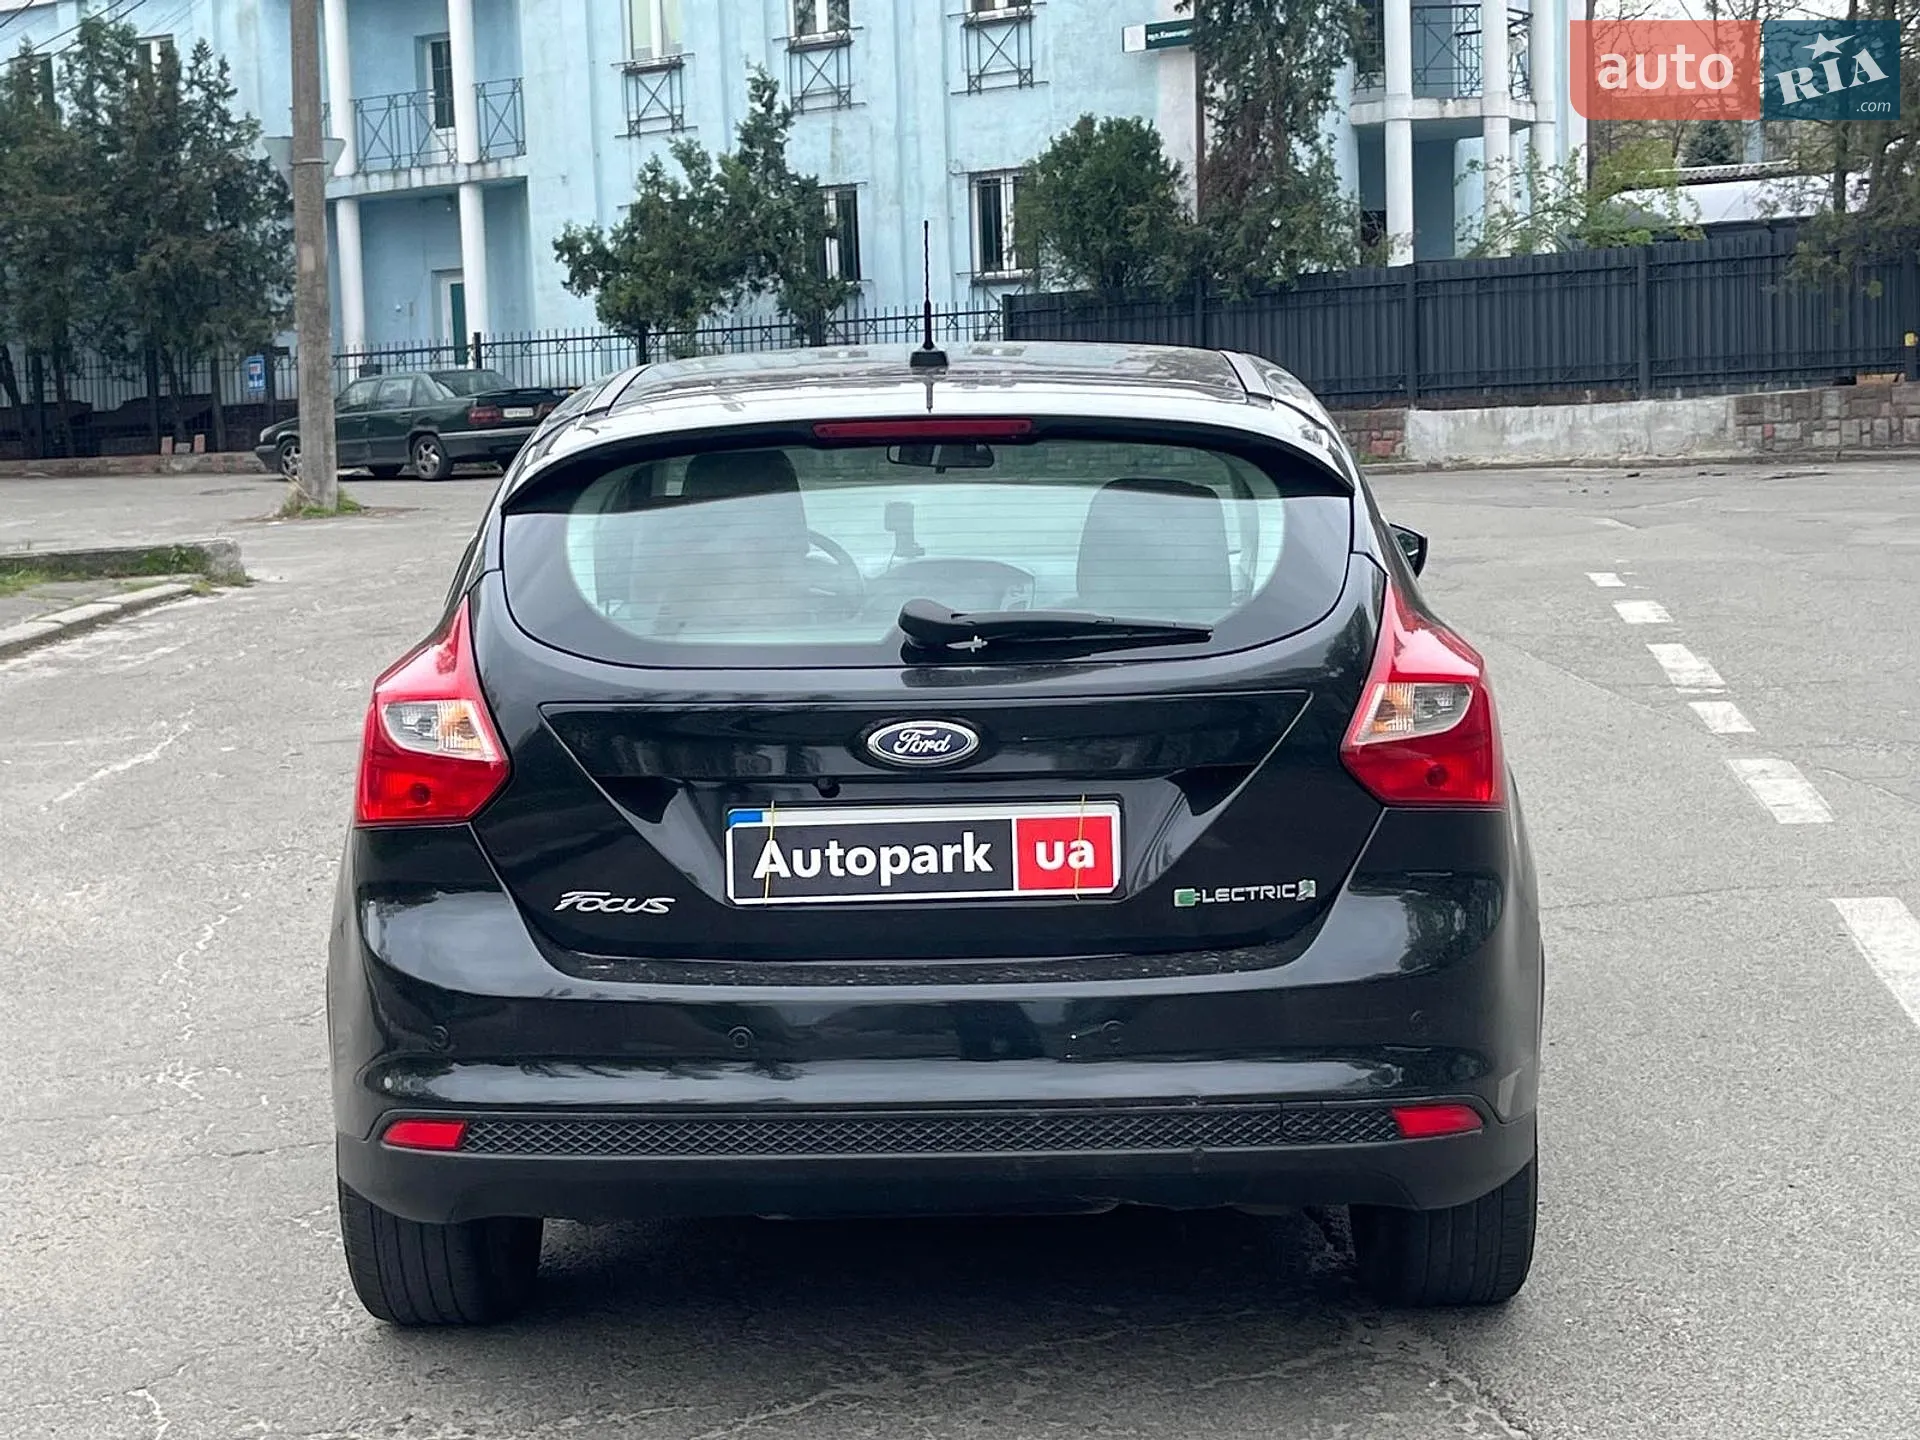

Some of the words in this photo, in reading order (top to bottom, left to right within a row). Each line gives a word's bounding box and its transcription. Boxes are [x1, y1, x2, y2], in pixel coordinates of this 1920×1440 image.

[893, 729, 952, 754] Ford
[752, 831, 993, 887] Autopark
[1034, 838, 1096, 869] ua
